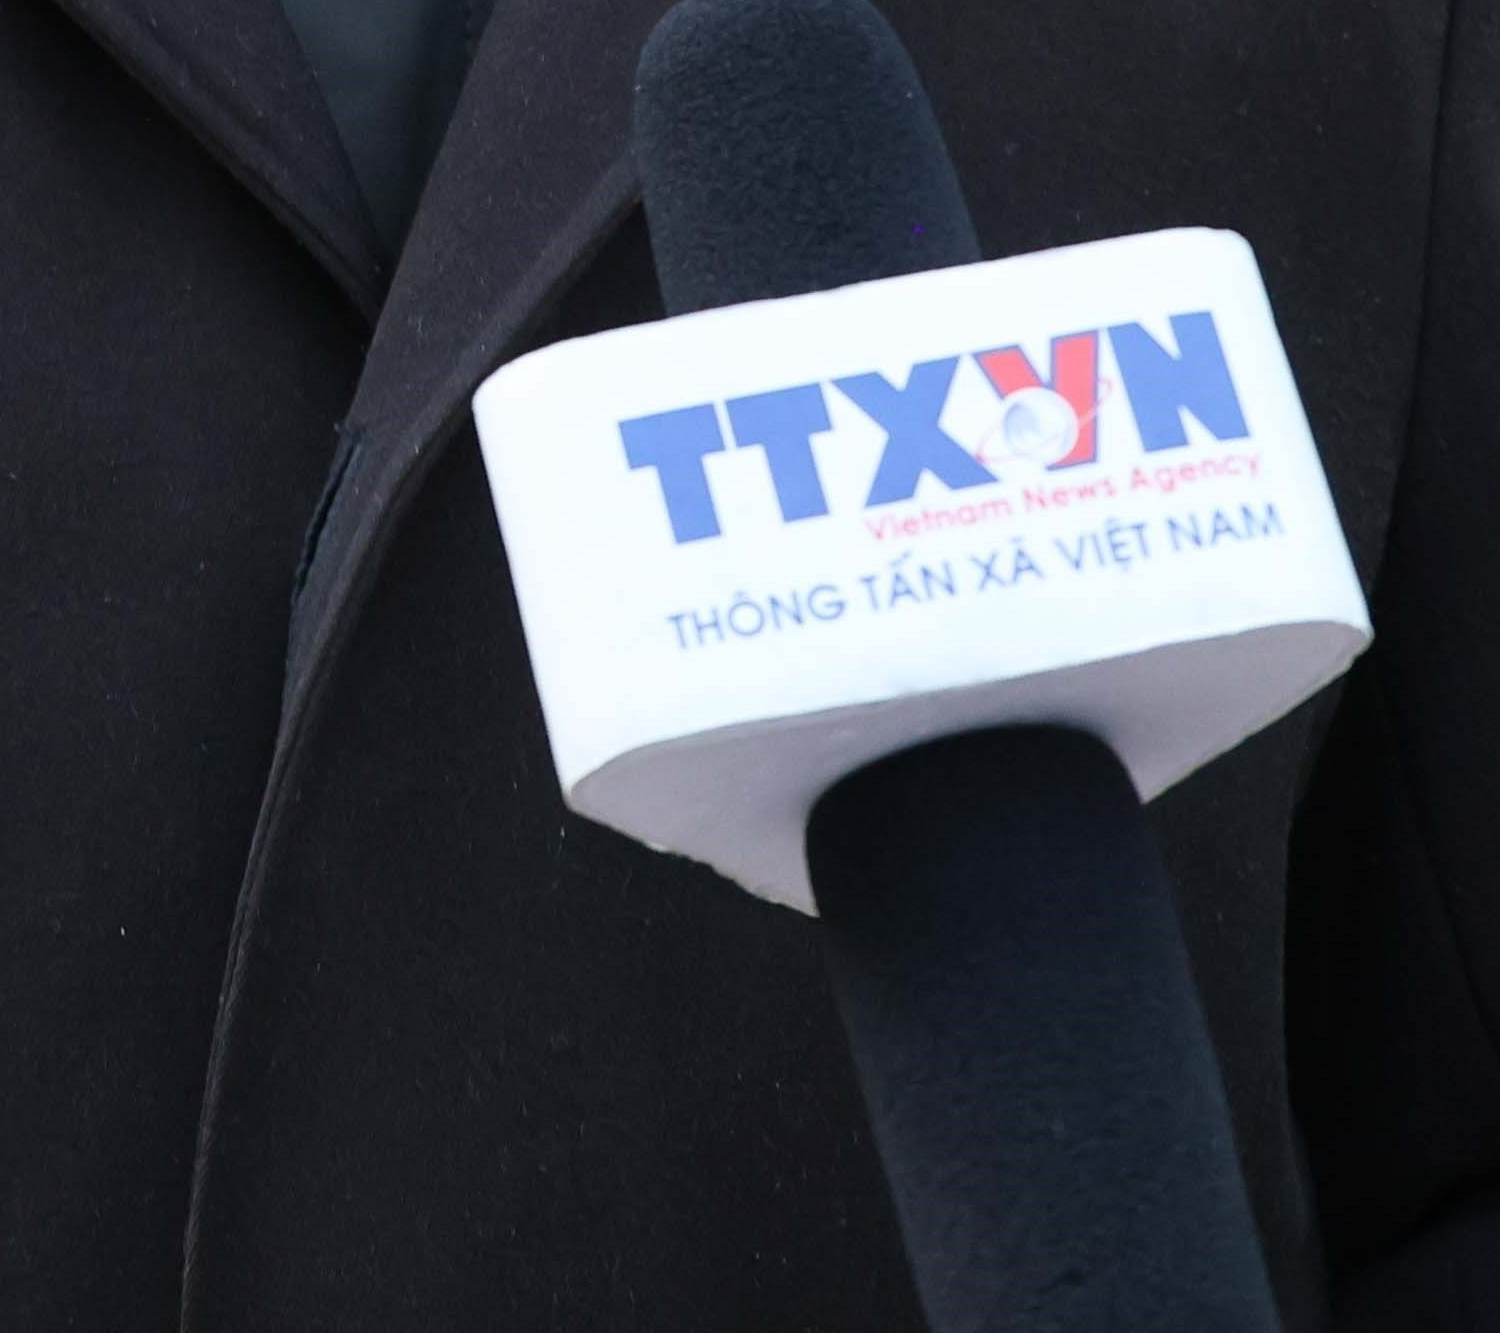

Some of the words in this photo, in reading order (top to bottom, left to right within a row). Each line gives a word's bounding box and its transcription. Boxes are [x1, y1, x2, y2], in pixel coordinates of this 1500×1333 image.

[617, 310, 1250, 544] TTXVN
[866, 493, 1013, 542] Vietnam
[1024, 473, 1116, 513] News
[1129, 452, 1263, 494] Agency
[668, 583, 847, 650] THÔNG
[860, 552, 958, 612] TẤN
[971, 536, 1043, 591] XÃ
[1056, 517, 1153, 572] VIỆT
[1166, 501, 1285, 550] NAM
